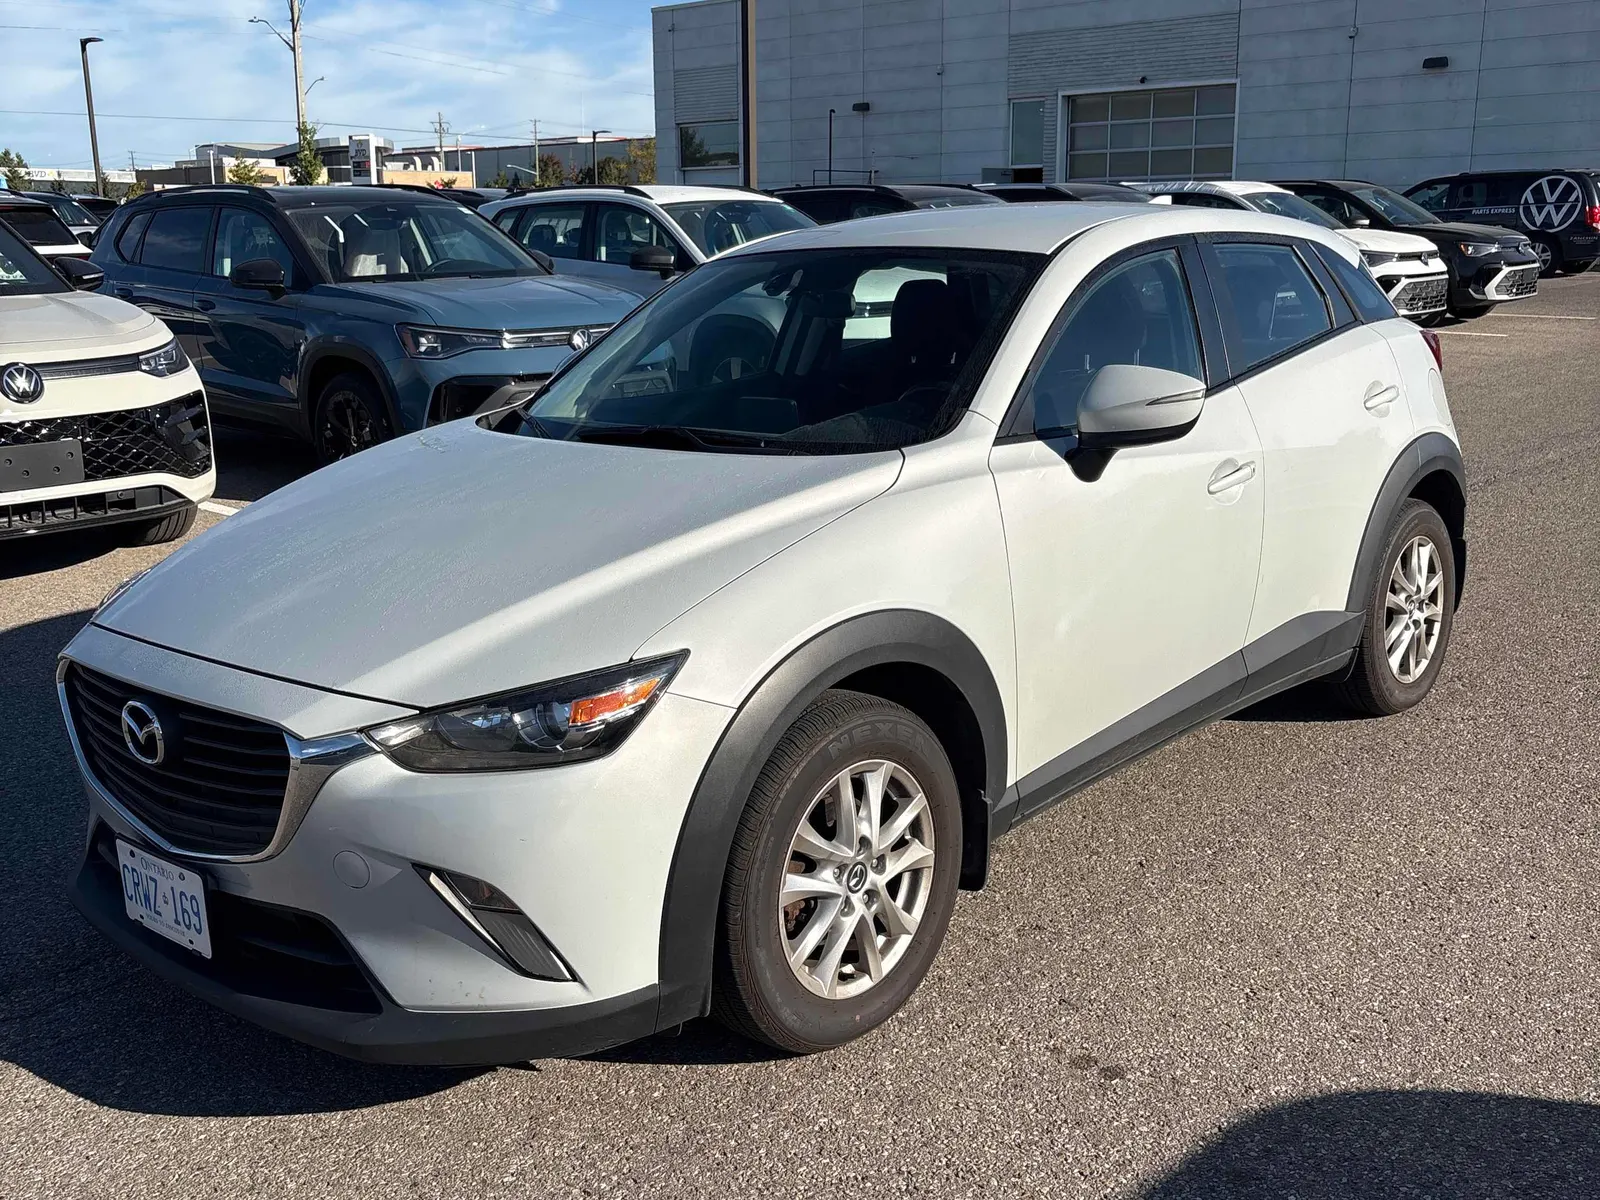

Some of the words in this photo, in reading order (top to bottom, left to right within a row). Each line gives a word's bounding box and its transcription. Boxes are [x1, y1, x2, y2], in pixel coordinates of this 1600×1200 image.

[1519, 175, 1583, 233] VW
[828, 721, 929, 760] NEXEN
[140, 856, 175, 881] ONTARIO
[121, 863, 162, 918] CRWZ
[170, 886, 203, 935] 169
